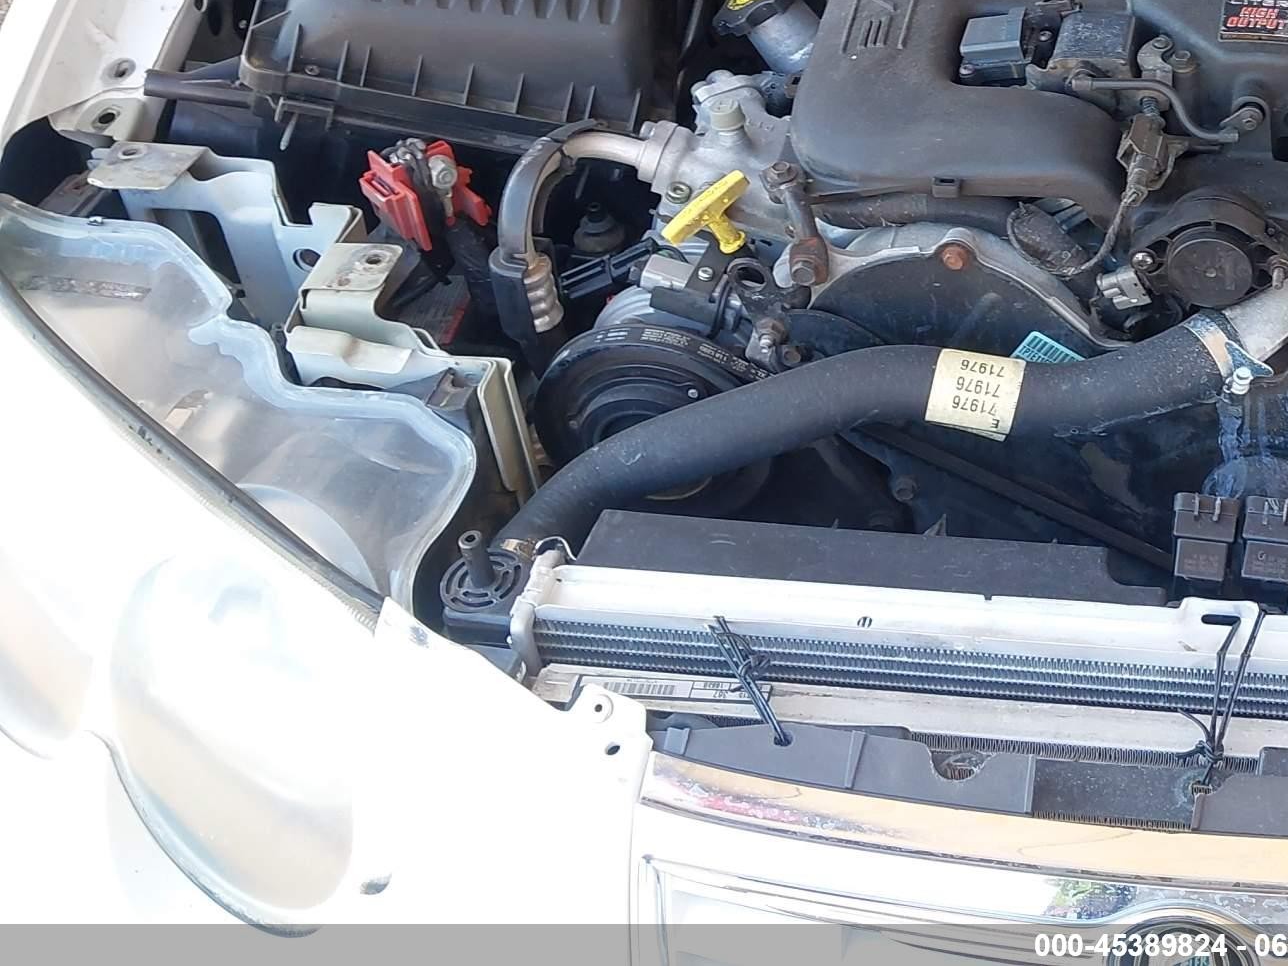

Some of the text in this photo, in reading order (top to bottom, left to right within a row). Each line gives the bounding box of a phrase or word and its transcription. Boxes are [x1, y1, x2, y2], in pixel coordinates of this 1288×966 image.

[1239, 6, 1280, 19] HIGH
[1226, 16, 1288, 30] OUTPUT
[959, 358, 1006, 379] 71976
[955, 376, 1001, 399] 71976
[951, 395, 1001, 417] 71976
[989, 418, 1001, 430] E
